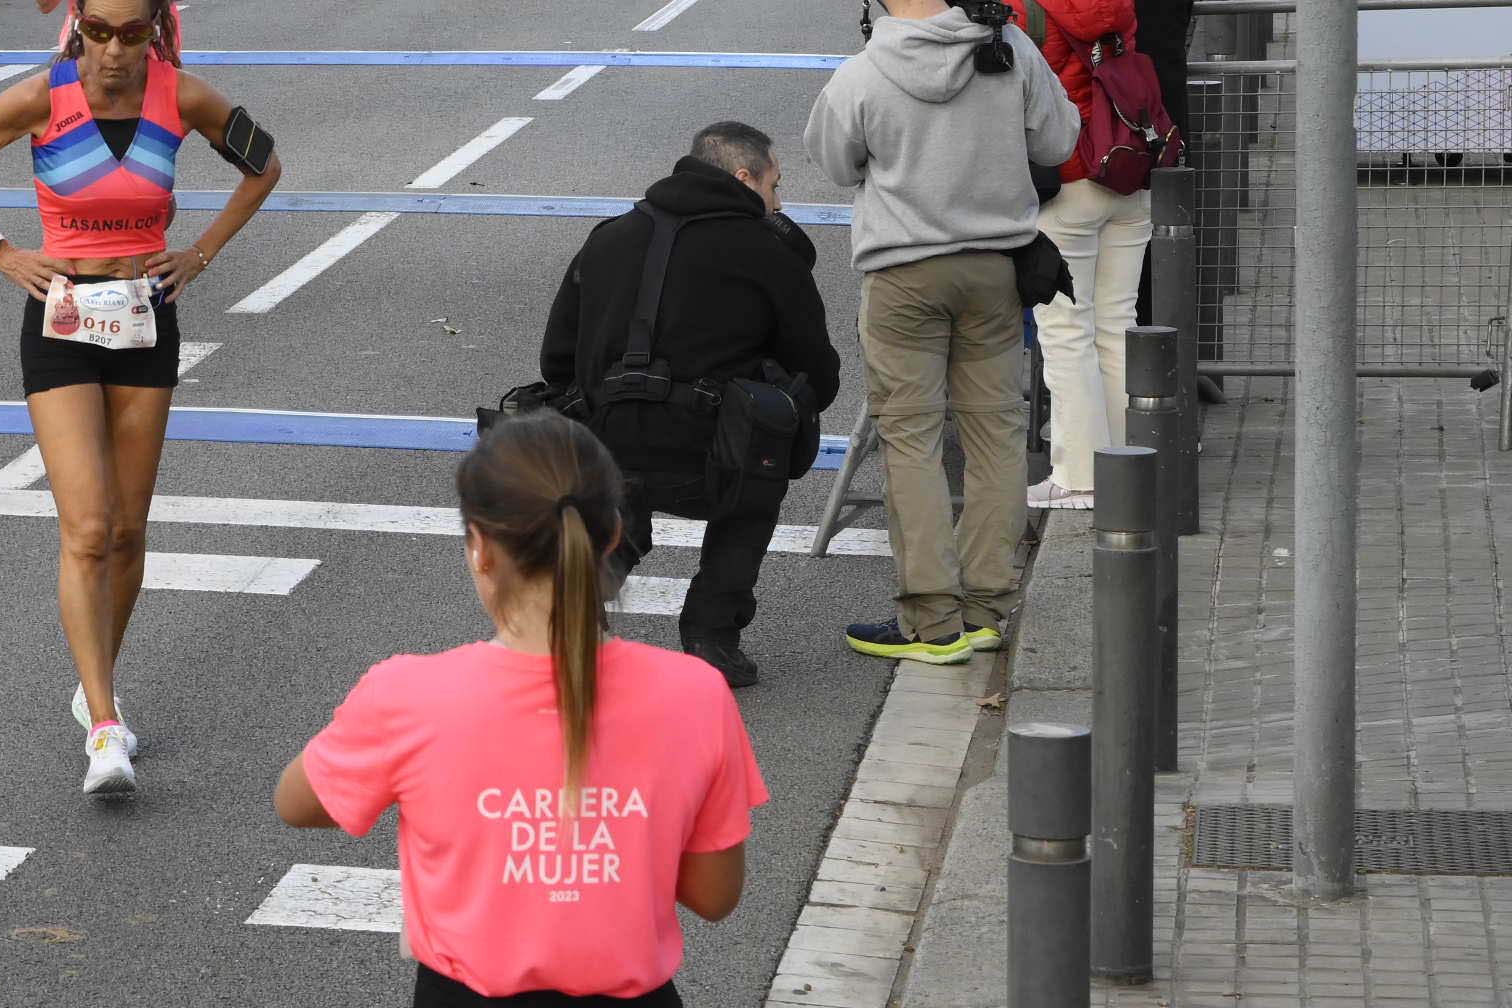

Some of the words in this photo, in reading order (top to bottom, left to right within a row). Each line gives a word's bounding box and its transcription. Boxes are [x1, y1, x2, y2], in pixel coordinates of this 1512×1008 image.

[83, 316, 121, 333] 016
[89, 333, 112, 345] 8207
[511, 821, 558, 851] DE
[572, 820, 615, 850] LA
[502, 853, 621, 884] MUJER
[549, 890, 580, 902] 2023
